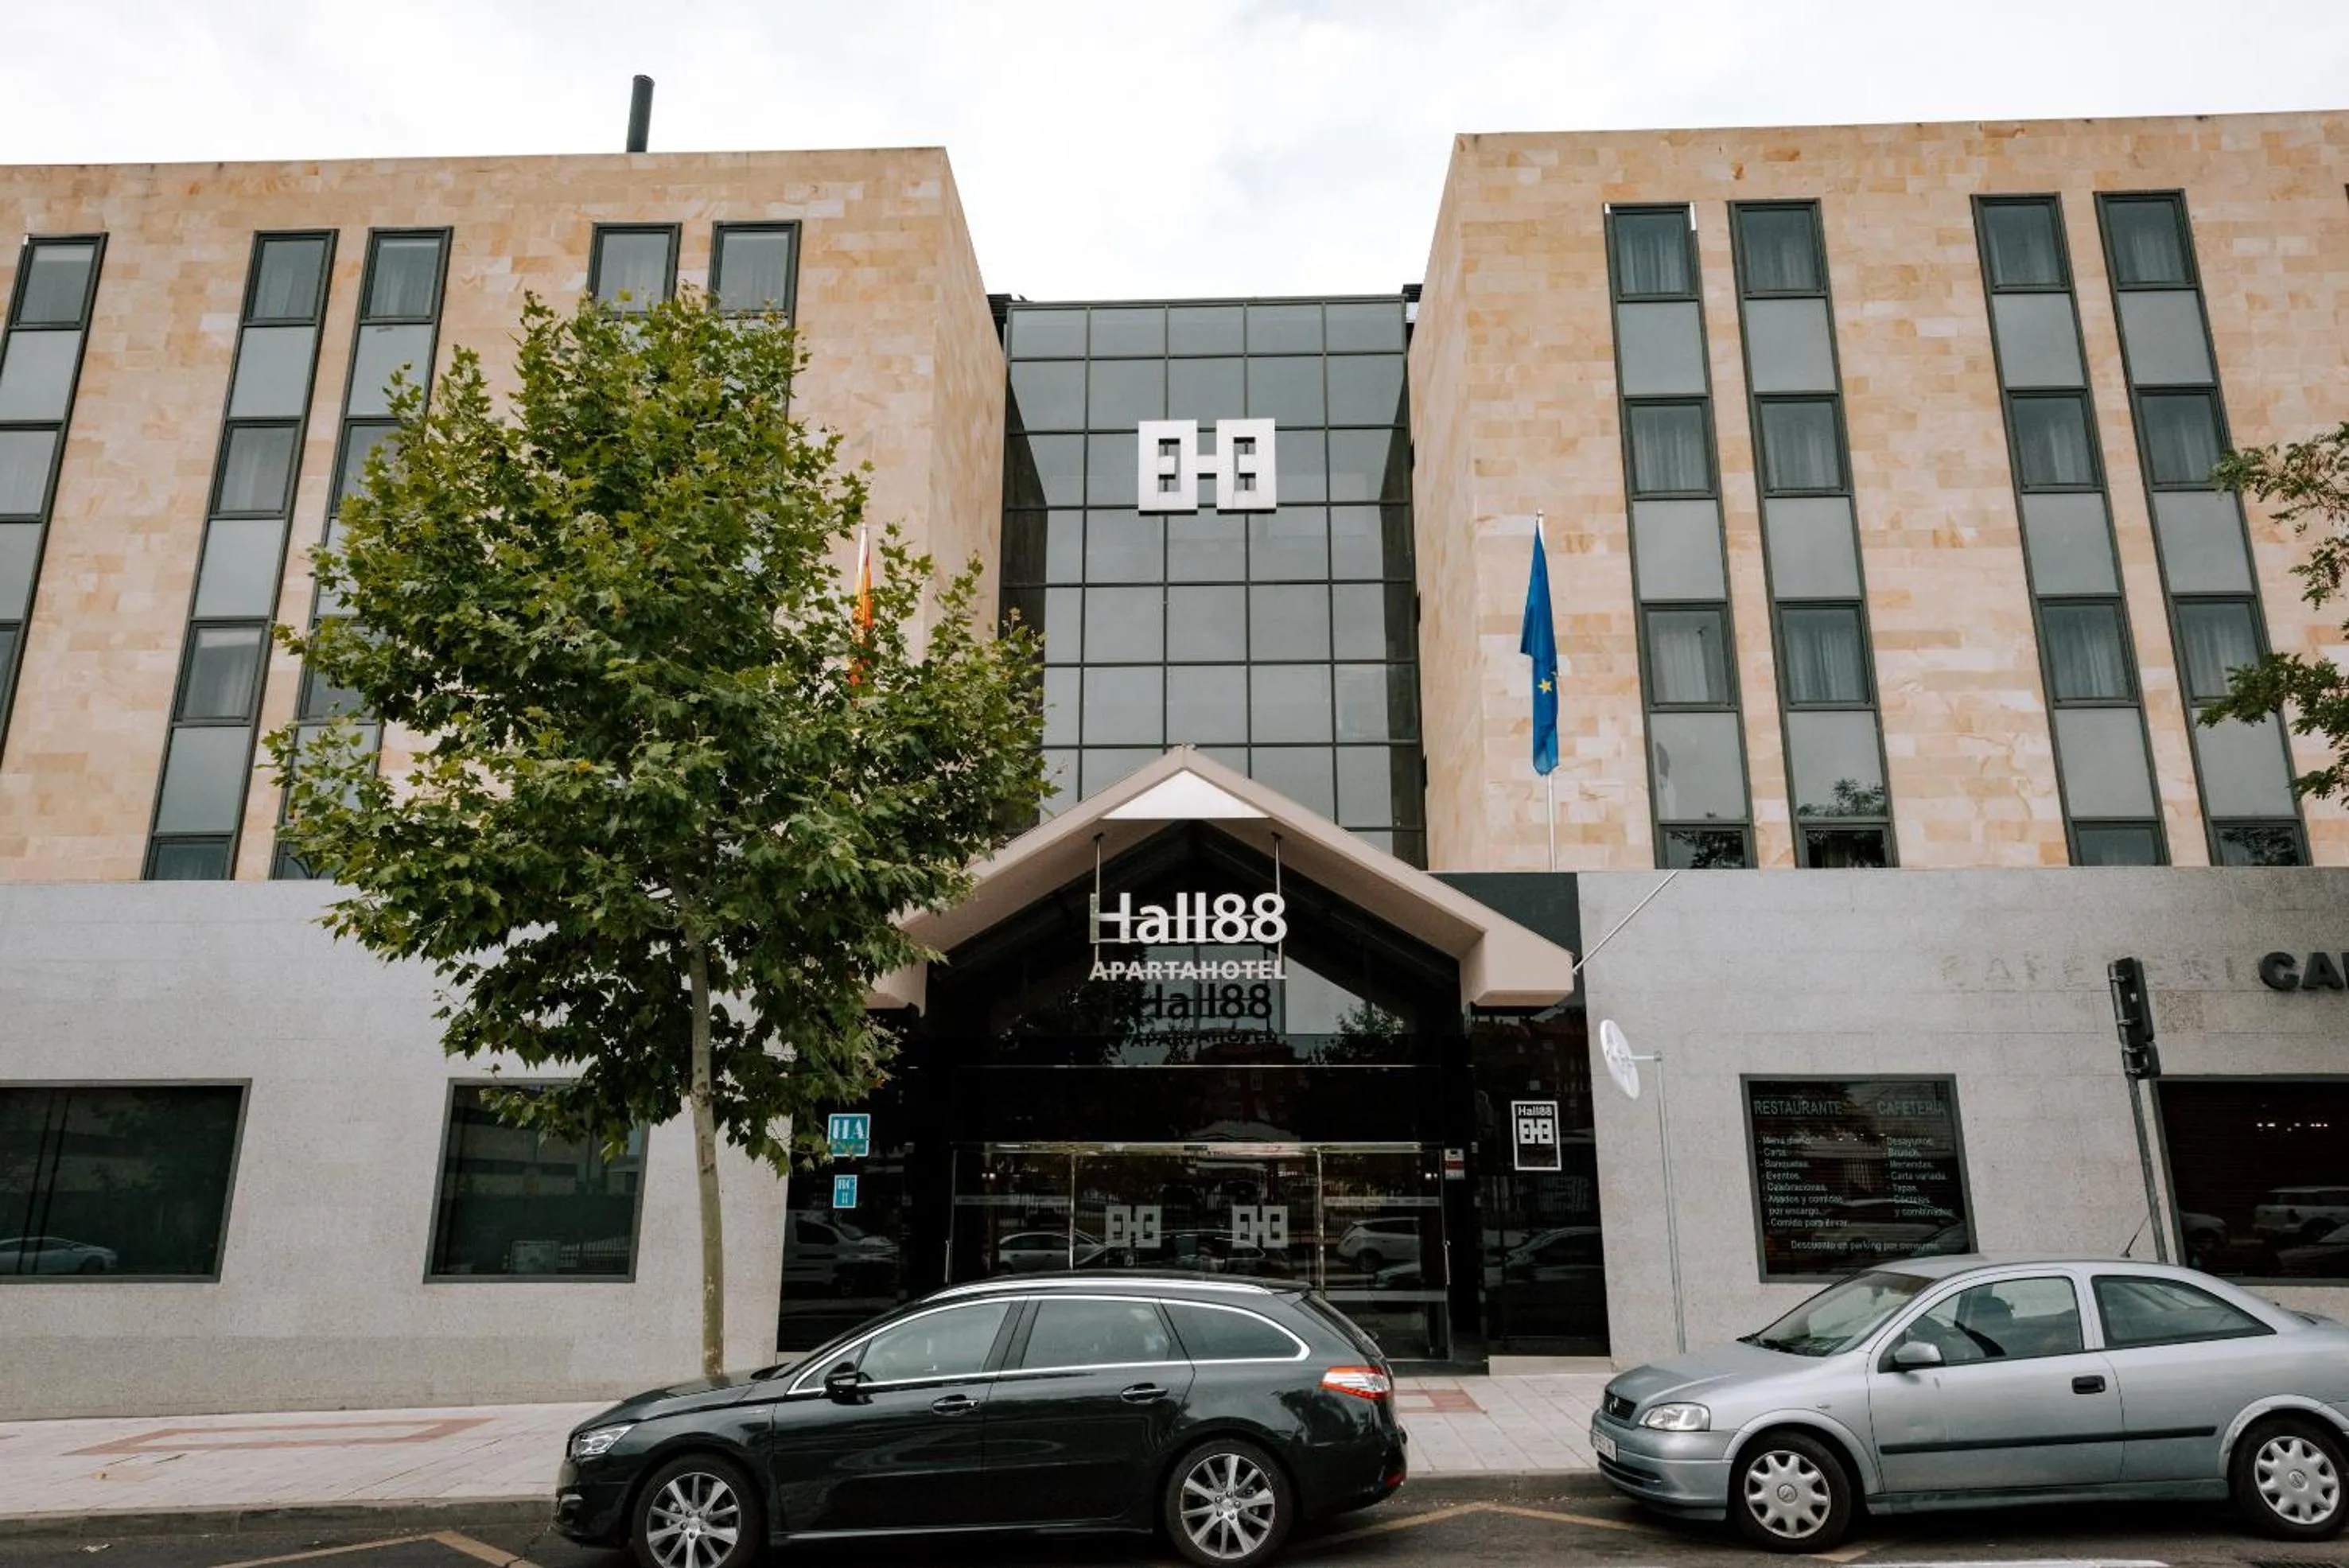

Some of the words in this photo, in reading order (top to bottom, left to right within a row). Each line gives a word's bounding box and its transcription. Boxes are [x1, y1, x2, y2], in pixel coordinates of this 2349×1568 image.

[1090, 892, 1287, 944] Hall88
[1089, 961, 1287, 980] APARTAHOTEL
[1518, 1105, 1553, 1116] Hall88
[1753, 1100, 1843, 1115] RESTAURANTE
